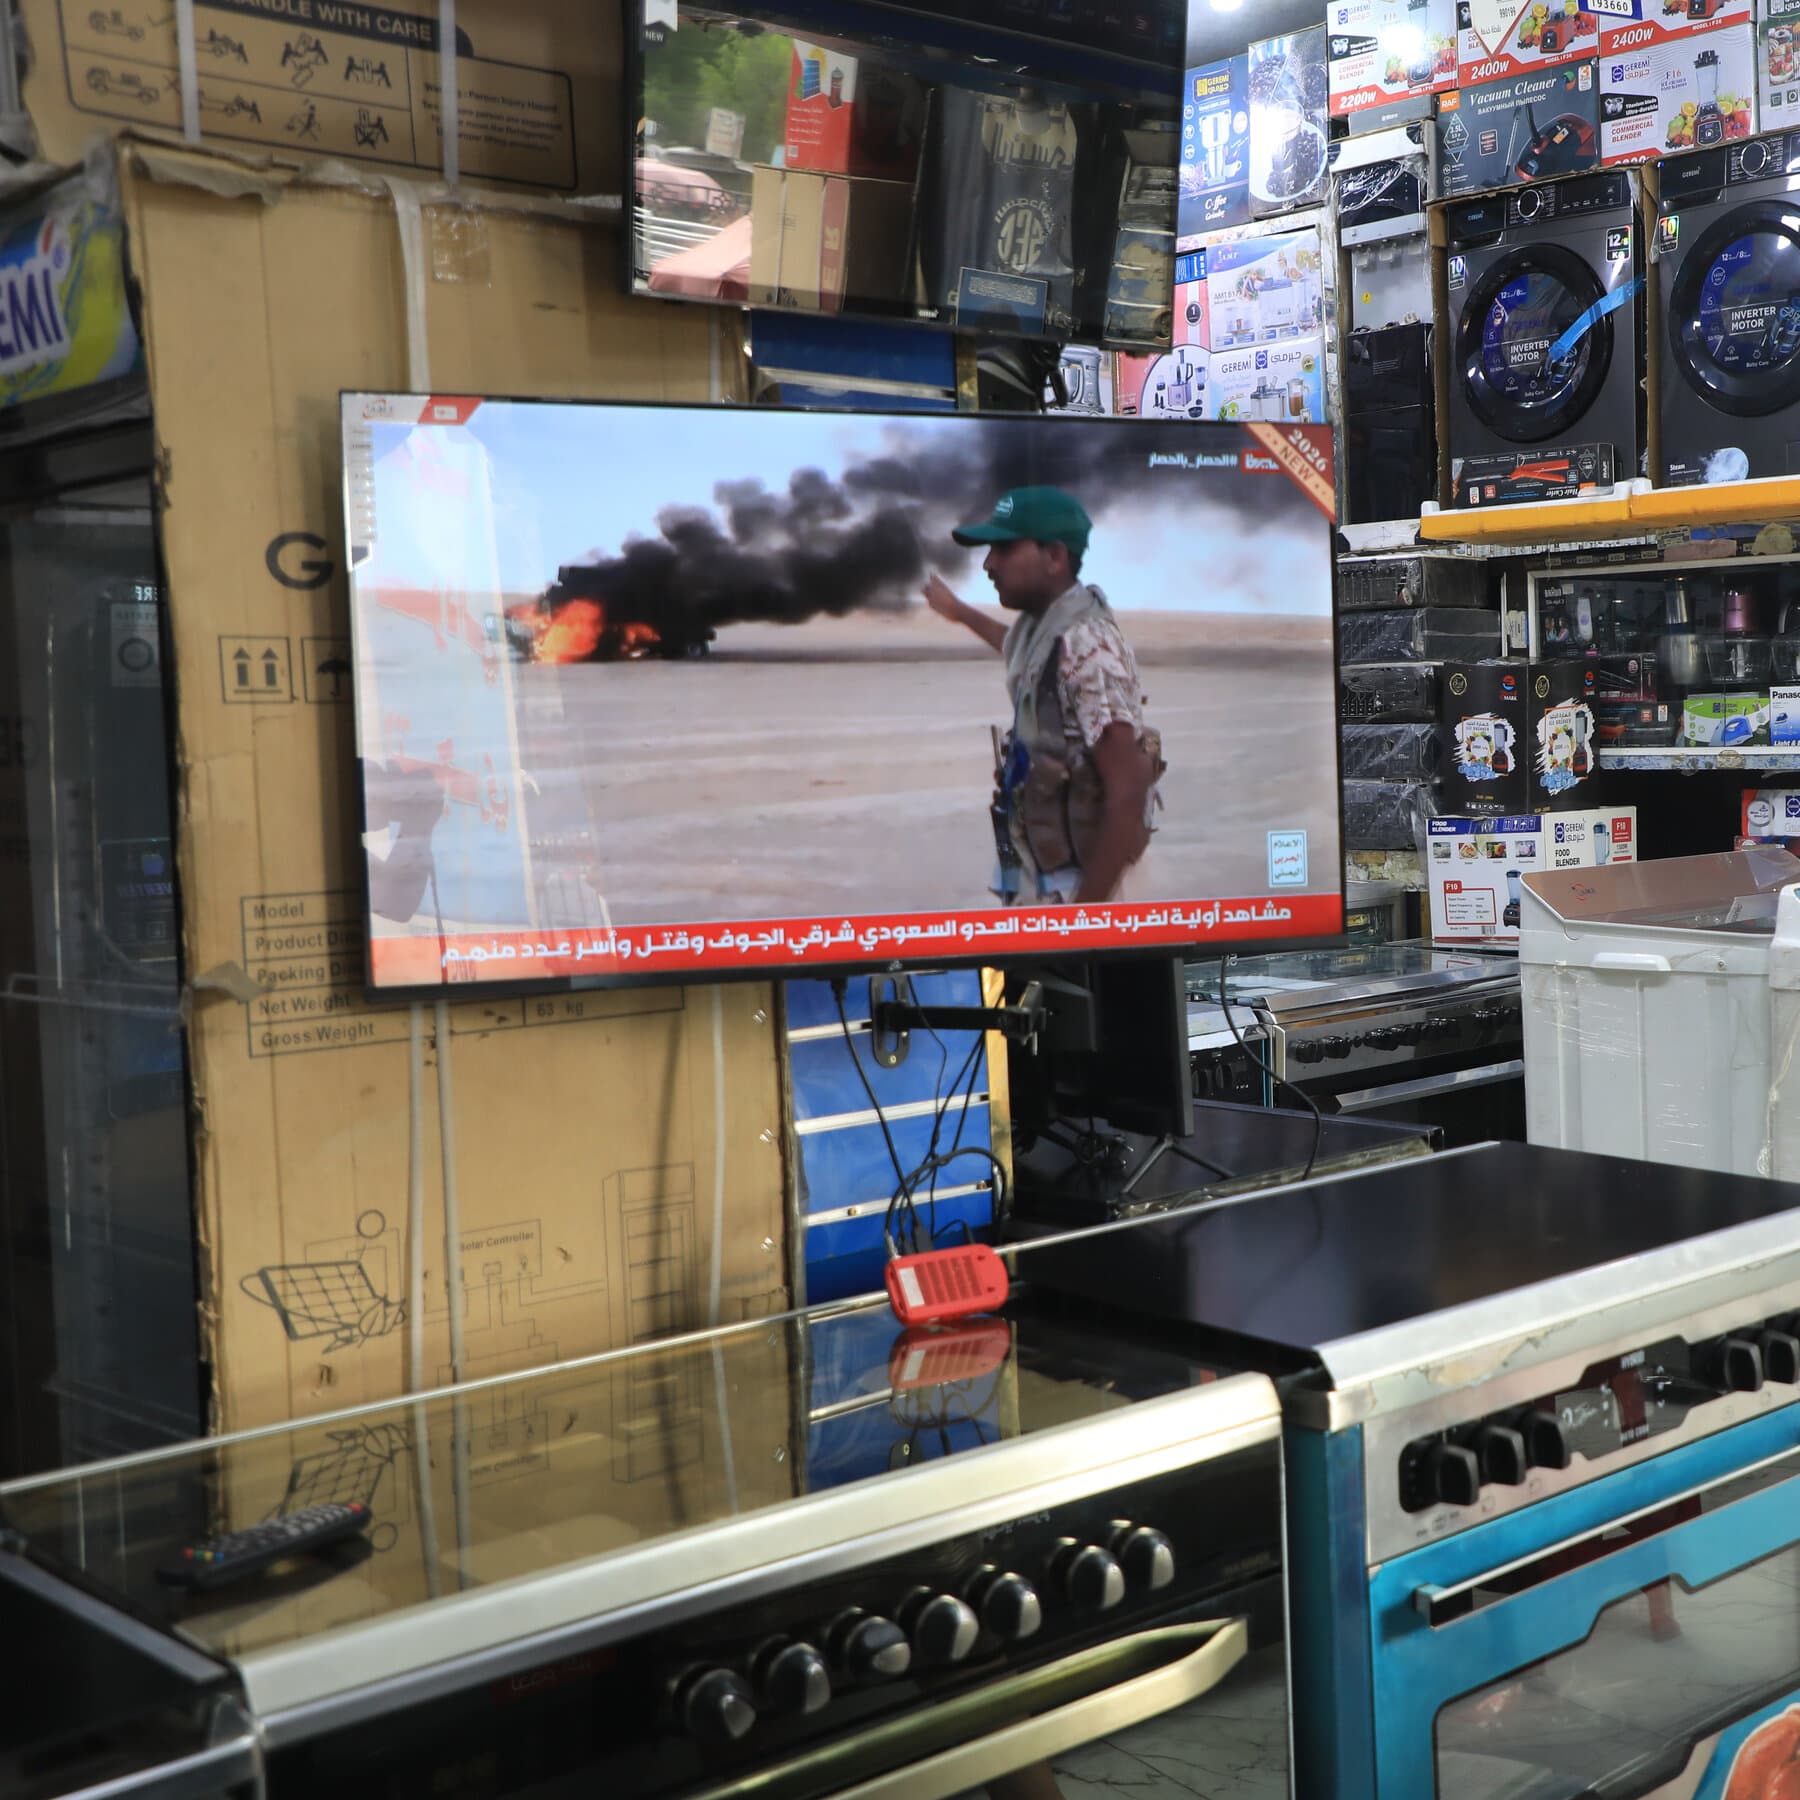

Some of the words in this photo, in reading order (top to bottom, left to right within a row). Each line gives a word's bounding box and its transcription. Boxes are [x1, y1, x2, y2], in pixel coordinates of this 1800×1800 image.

[316, 4, 371, 31] WITH
[375, 18, 432, 42] CARE
[645, 31, 664, 41] NEW
[1339, 70, 1365, 81] BLENDER
[1624, 59, 1650, 72] GEREMI
[1470, 88, 1511, 106] Vacuum
[1515, 77, 1557, 98] Cleaner
[1441, 98, 1457, 108] RAF
[1611, 120, 1655, 135] COMMERCIAL
[1611, 131, 1642, 143] BLENDER
[1205, 194, 1228, 210] Coffee
[1660, 217, 1677, 238] 10
[1450, 258, 1464, 275] 10
[1731, 306, 1776, 320] INVERTER
[1731, 319, 1764, 331] MOTOR
[1510, 340, 1550, 354] INVERTER
[1510, 351, 1540, 363] MOTOR
[1221, 353, 1252, 374] GEREMI
[1288, 428, 1329, 472] 2026
[1280, 445, 1316, 482] NEW
[265, 531, 335, 590] G
[1564, 823, 1585, 832] GEREMI
[1555, 849, 1570, 857] FOOD
[1555, 857, 1580, 867] BLENDER
[253, 902, 304, 920] Model
[1115, 907, 1170, 931] لضرب
[1171, 902, 1222, 929] أولية
[1223, 900, 1292, 923] مشاهد
[857, 918, 957, 947] السعودي
[960, 918, 1019, 942] العدو
[1022, 909, 1112, 937] تحشيدات
[255, 932, 323, 951] Product
[576, 930, 631, 959] وأسر
[637, 933, 705, 959] وقتل
[709, 928, 784, 953] الجوف
[788, 921, 855, 955] شرقي
[442, 944, 516, 967] منهم
[521, 940, 571, 958] عدد
[257, 964, 325, 984] Packing
[259, 999, 288, 1015] Net
[293, 992, 350, 1012] Weight
[566, 999, 584, 1017] kg
[262, 1030, 311, 1048] Gross
[317, 1022, 375, 1042] Weight
[486, 1230, 534, 1248] Controller
